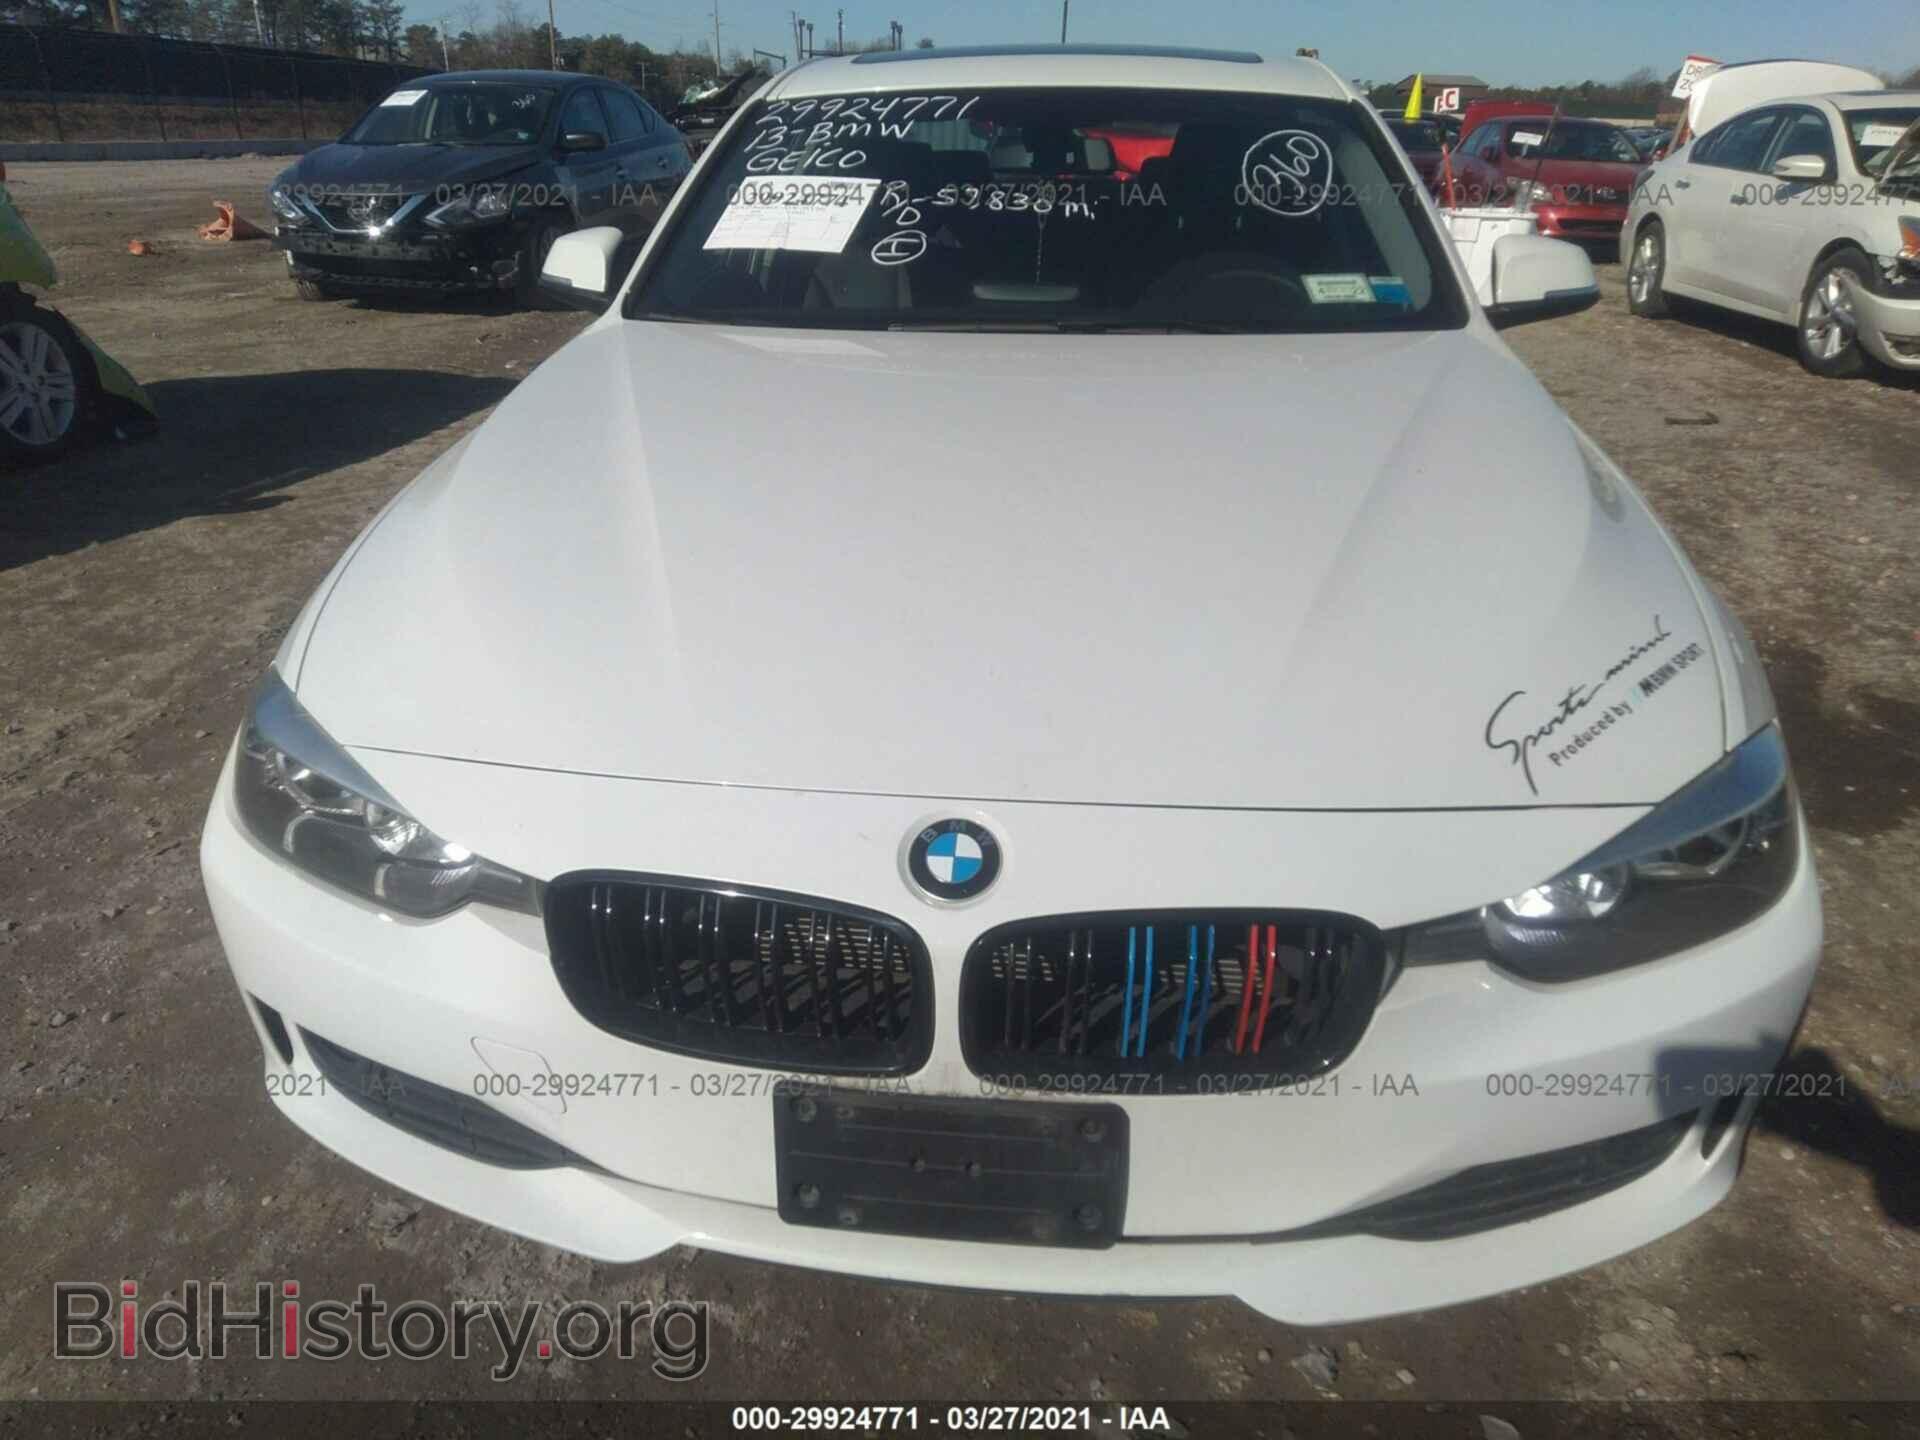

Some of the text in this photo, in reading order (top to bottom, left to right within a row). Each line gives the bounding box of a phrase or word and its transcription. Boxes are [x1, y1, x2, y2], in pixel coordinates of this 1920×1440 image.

[756, 96, 979, 125] 29924771
[746, 148, 866, 172] GEICO
[1253, 136, 1319, 200] 360
[1549, 712, 1616, 767] Produced
[1609, 700, 1633, 722] by
